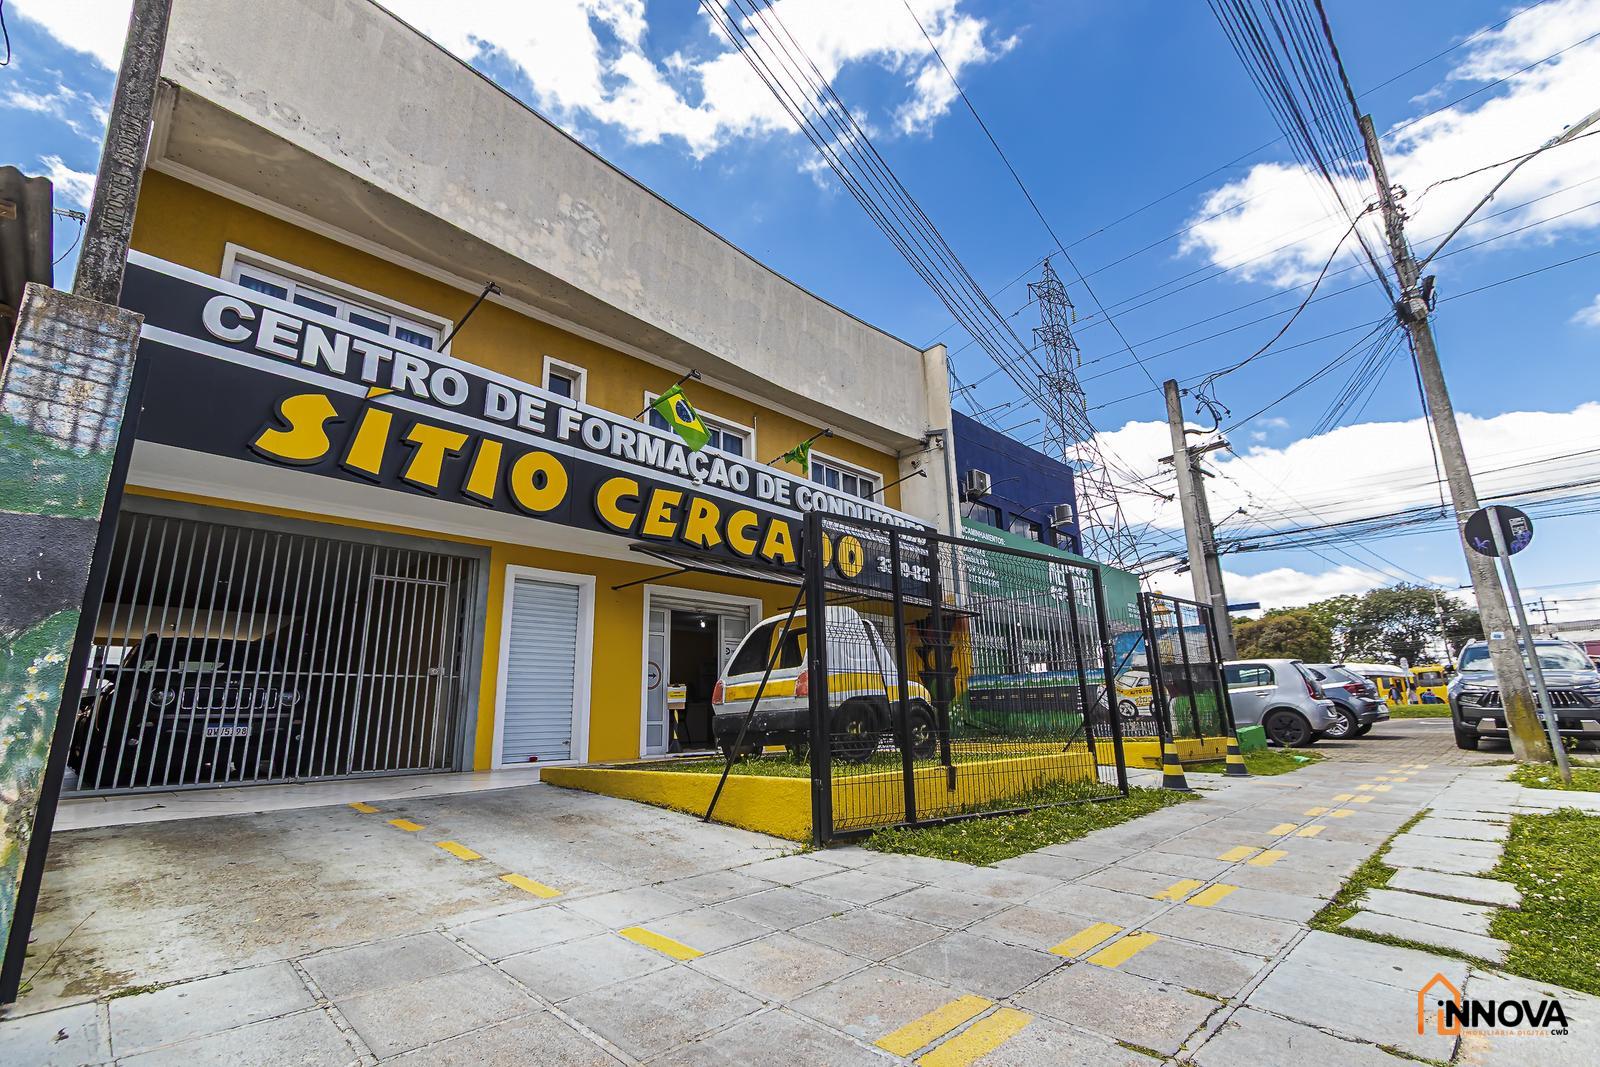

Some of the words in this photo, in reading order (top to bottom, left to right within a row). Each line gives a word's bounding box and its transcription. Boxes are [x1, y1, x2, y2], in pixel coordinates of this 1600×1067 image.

[201, 294, 470, 407] CENTRO
[484, 383, 547, 434] DE
[556, 408, 753, 494] FORMAÇÃO
[755, 472, 791, 505] DE
[253, 386, 571, 517] SÍTIO
